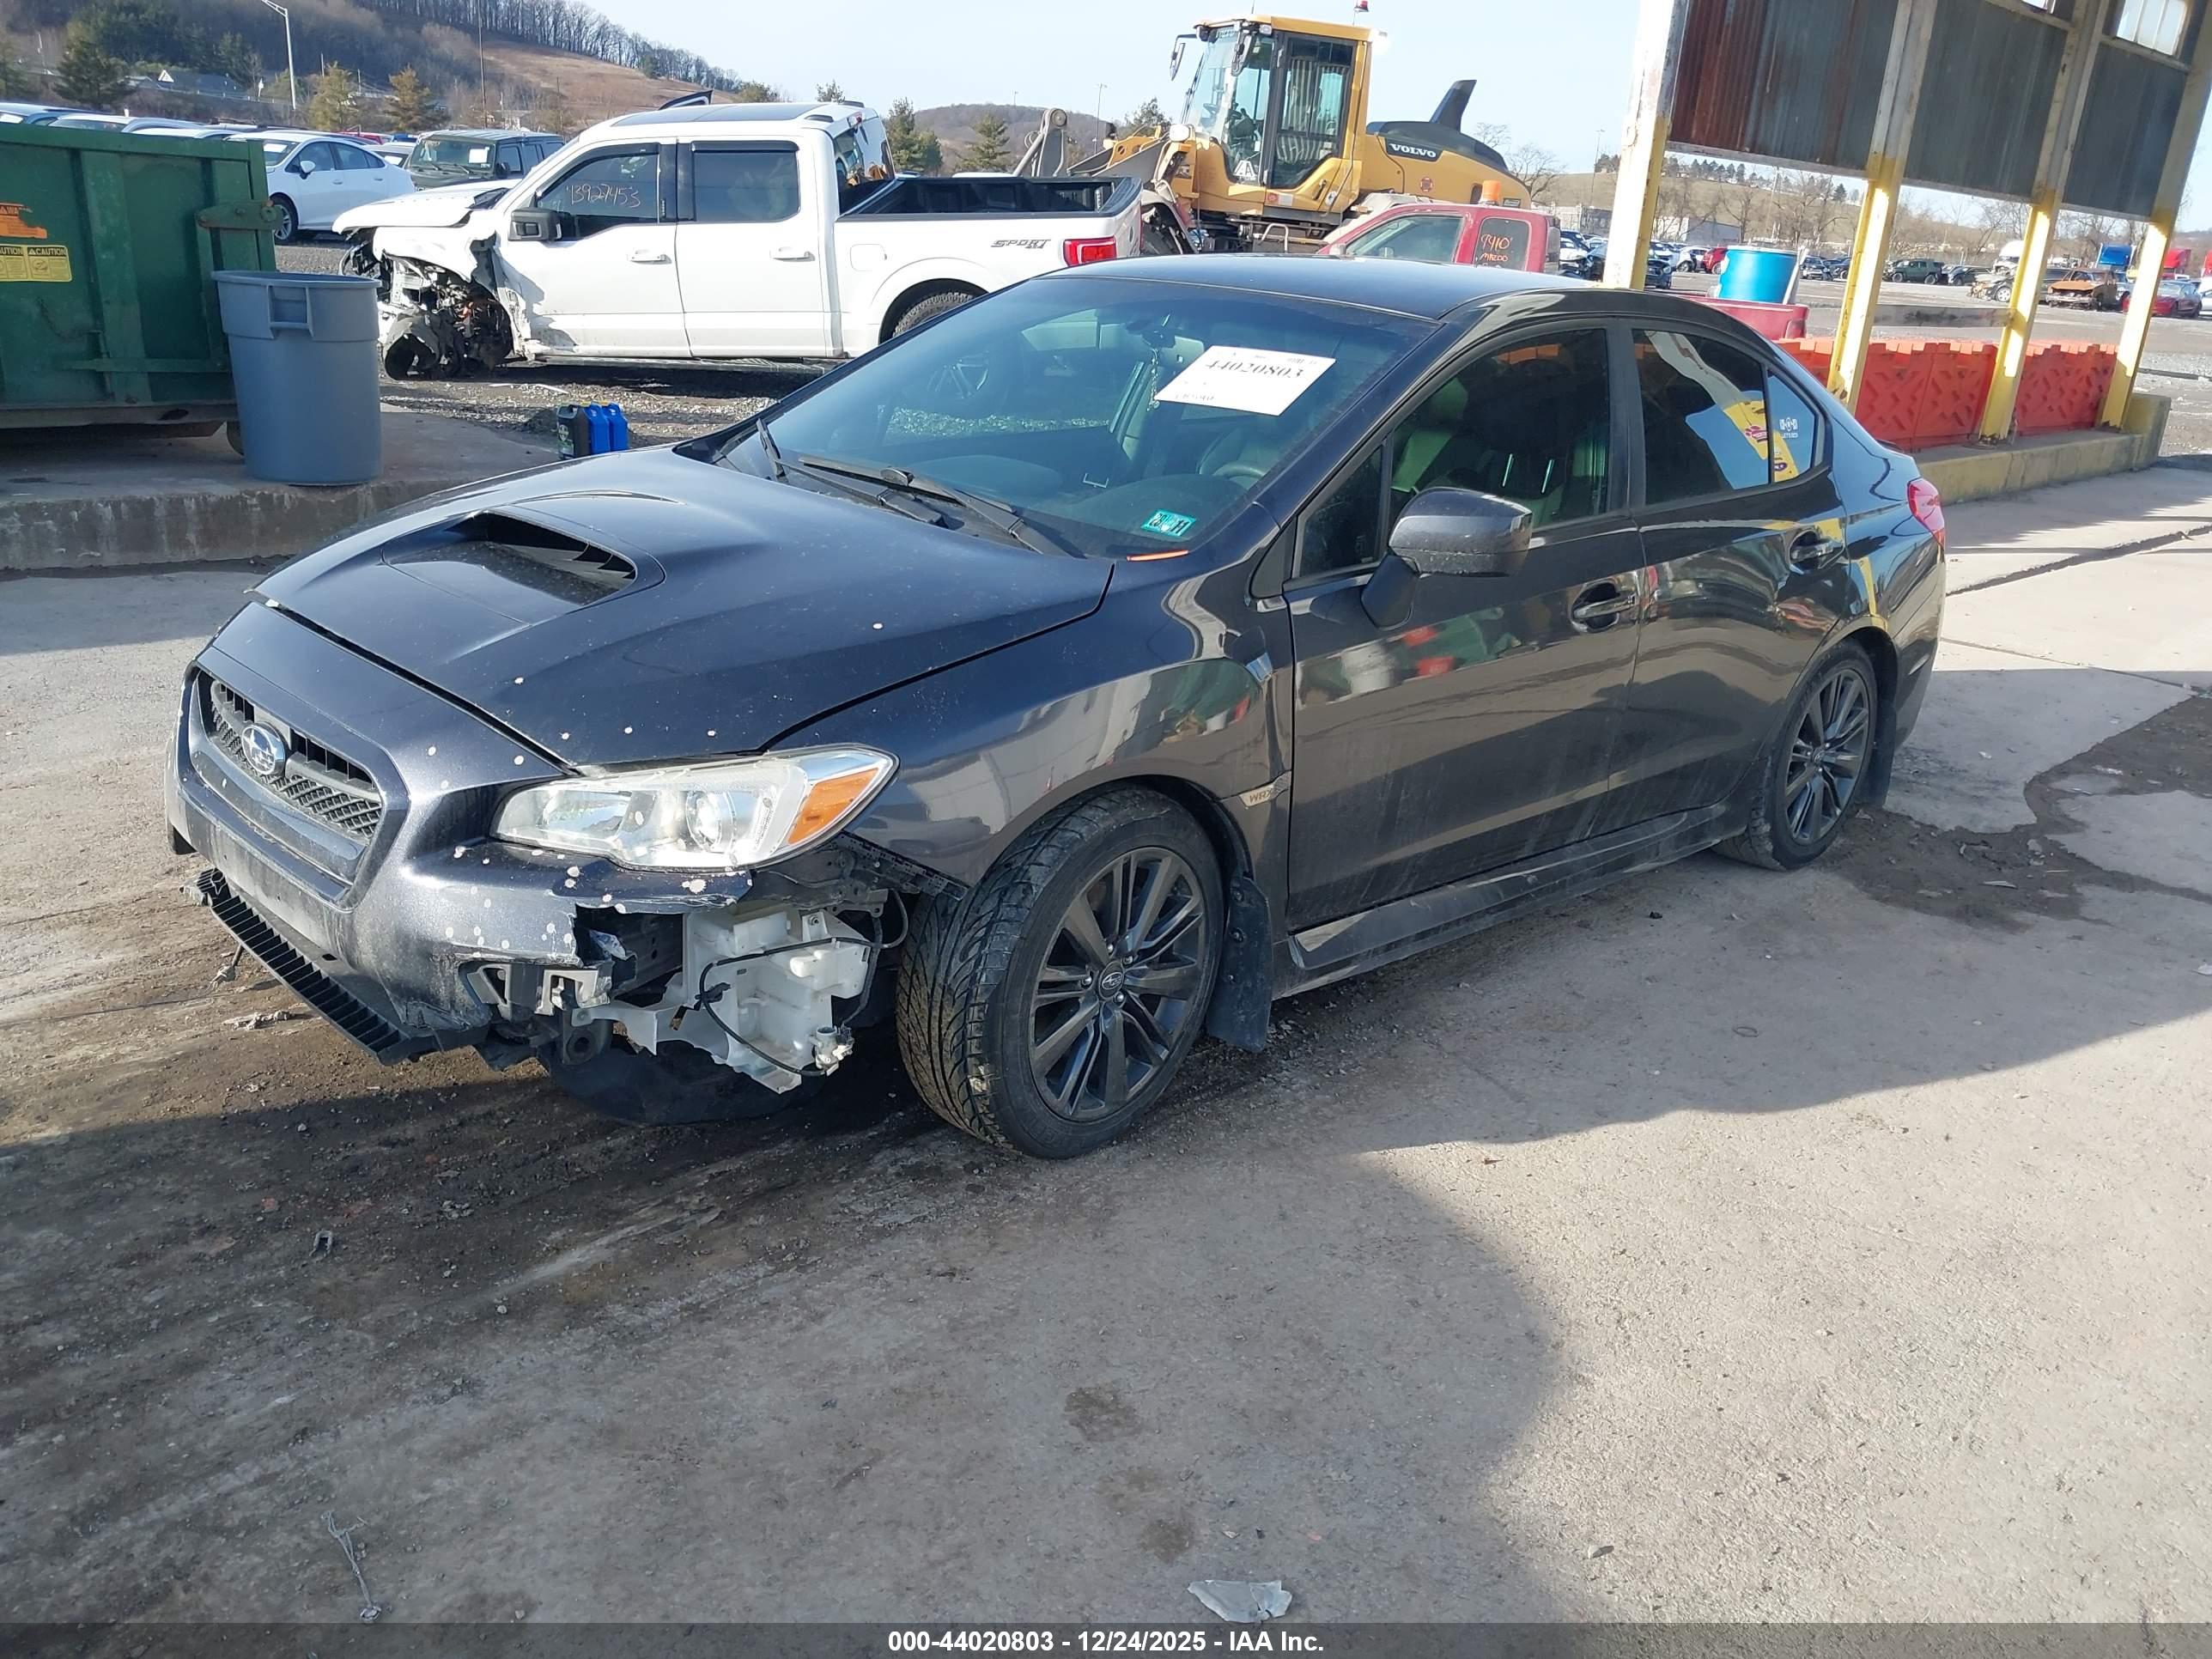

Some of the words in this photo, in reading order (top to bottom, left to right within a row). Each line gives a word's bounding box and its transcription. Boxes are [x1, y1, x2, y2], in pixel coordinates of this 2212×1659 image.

[1389, 143, 1437, 158] VOLVO
[990, 239, 1052, 249] SPORT
[35, 247, 67, 256] CAUTION
[1204, 359, 1304, 379] 44020803
